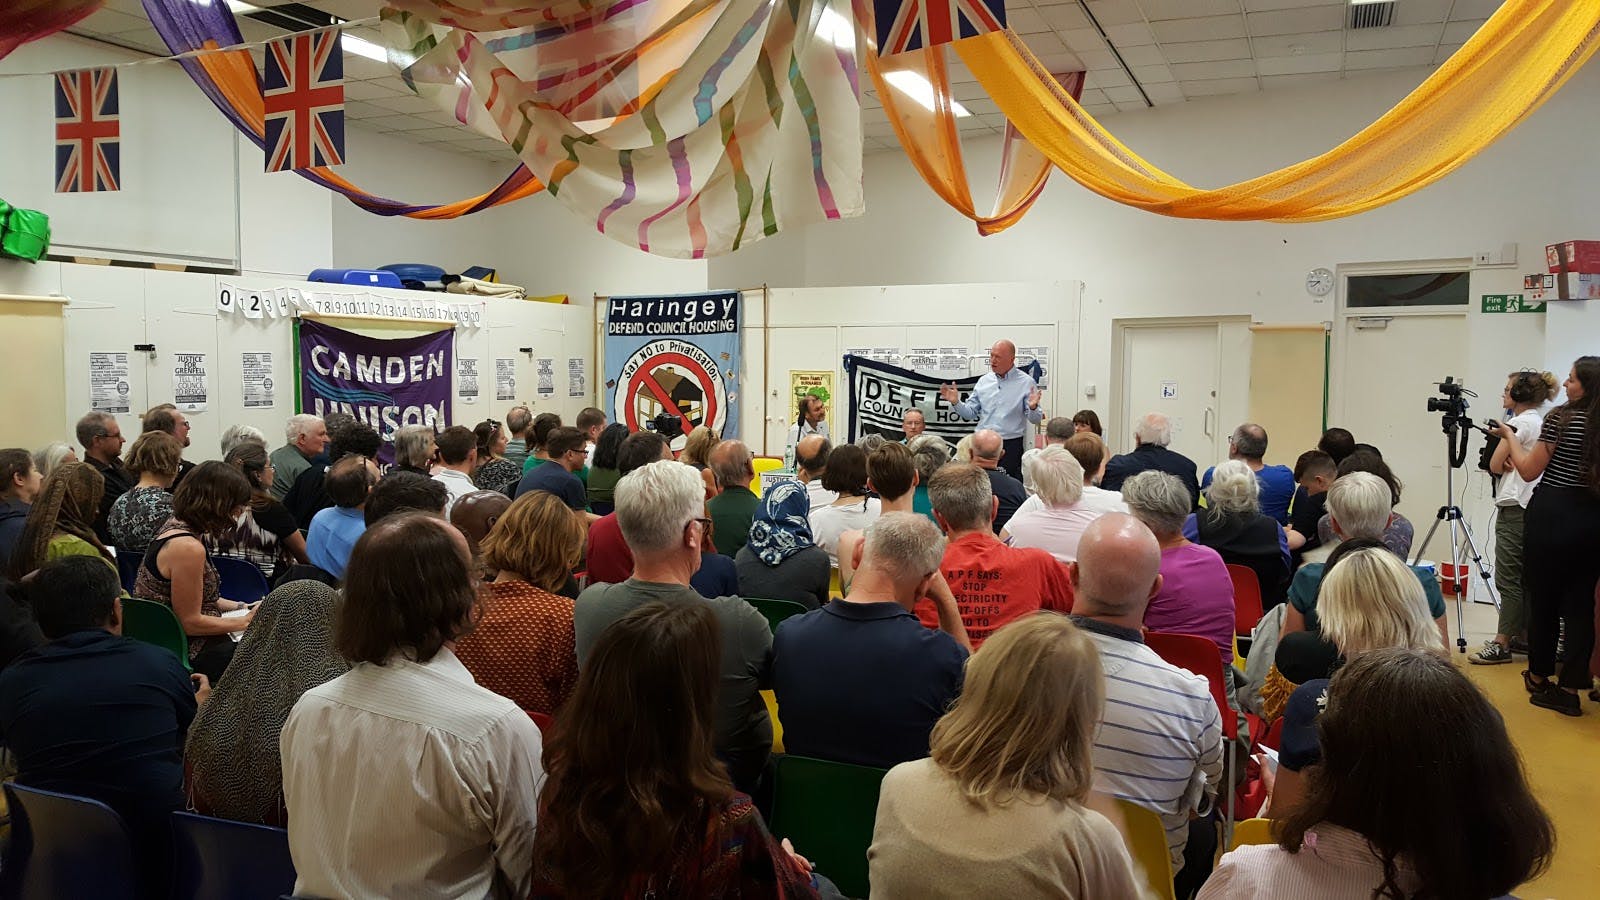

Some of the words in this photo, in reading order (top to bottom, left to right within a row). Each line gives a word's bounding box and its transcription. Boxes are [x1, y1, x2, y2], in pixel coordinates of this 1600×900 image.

[220, 290, 230, 306] 0
[240, 298, 245, 311] 1
[250, 295, 260, 311] 2
[265, 299, 272, 312] 3
[280, 297, 286, 309] 4
[316, 301, 321, 312] 7
[324, 301, 331, 313] 8
[334, 301, 341, 313] 9
[343, 302, 356, 314] 10
[357, 302, 368, 314] 11
[370, 302, 381, 315] 12
[384, 304, 394, 316] 13
[397, 306, 407, 317] 14
[412, 307, 421, 318] 15
[424, 308, 434, 319] 16
[437, 308, 448, 320] 17
[460, 312, 468, 322] 19
[470, 312, 480, 322] 20
[610, 298, 735, 322] Haringey
[609, 322, 644, 334] DEFEND
[646, 321, 686, 334] COUNCIL
[689, 320, 735, 333] HOUSING
[311, 345, 444, 383] CAMDEN
[625, 359, 640, 379] Say
[640, 347, 653, 361] NO
[656, 343, 665, 352] to
[669, 342, 718, 381] Privatisation
[977, 571, 1002, 580] SAYS:
[962, 582, 987, 591] STOP
[977, 618, 989, 626] TO
